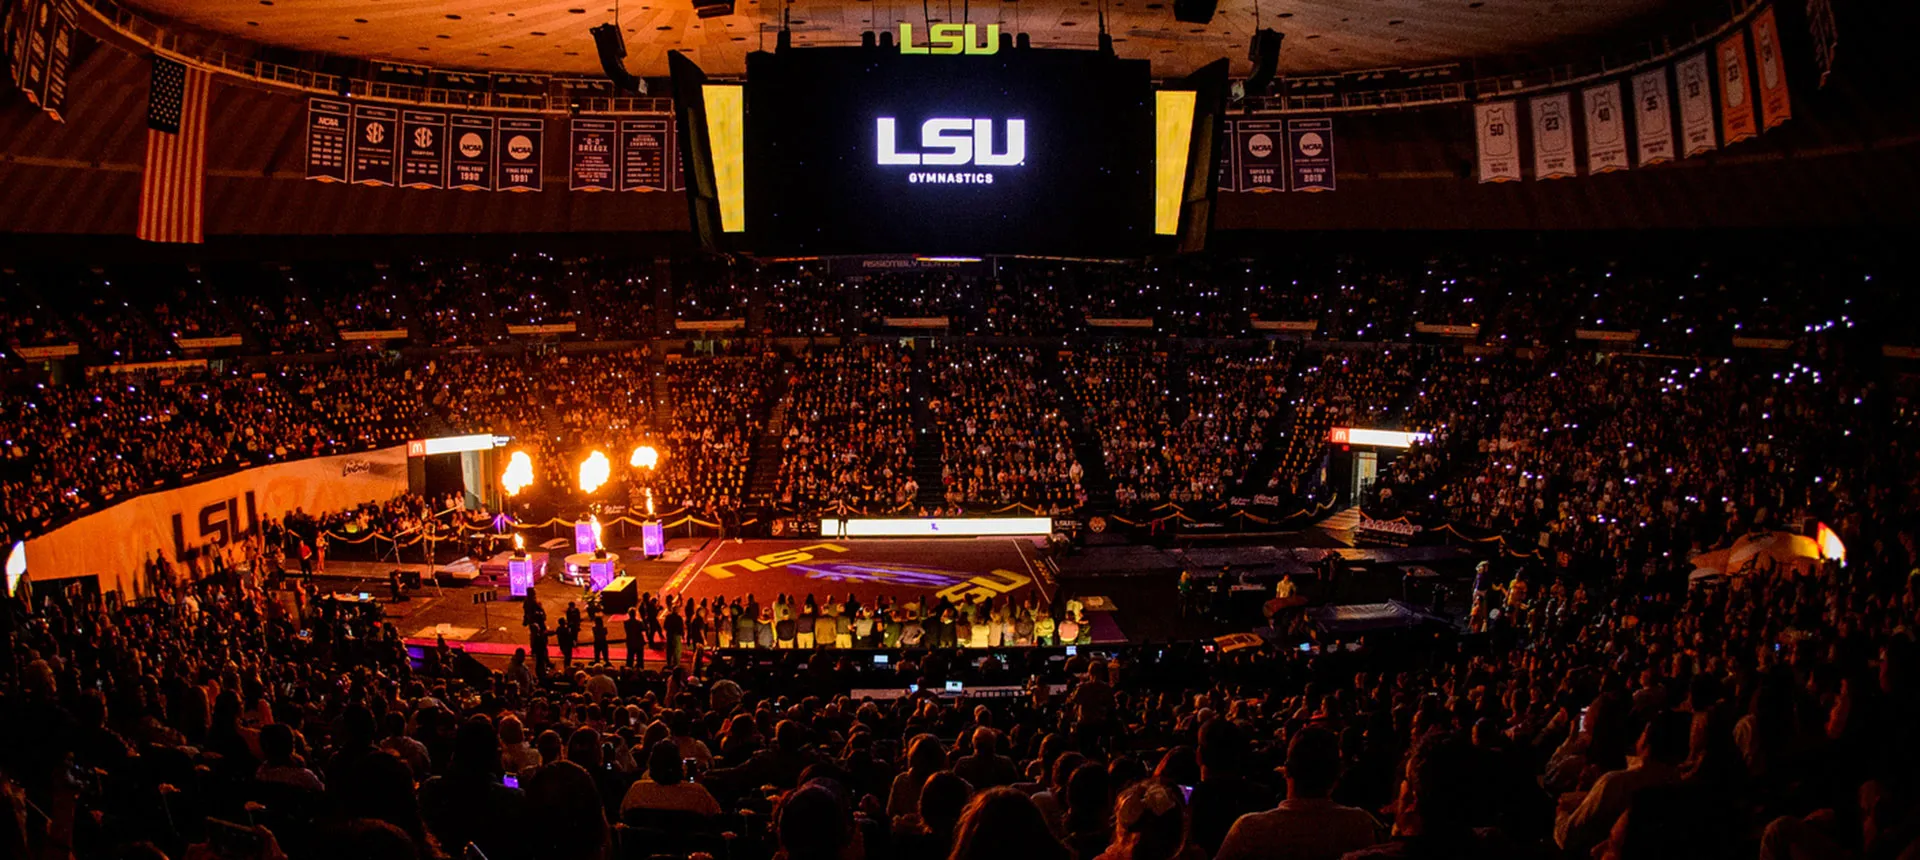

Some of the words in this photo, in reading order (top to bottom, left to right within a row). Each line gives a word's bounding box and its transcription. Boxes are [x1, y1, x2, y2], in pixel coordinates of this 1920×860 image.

[900, 23, 999, 54] LSU
[366, 122, 385, 144] SEC
[1490, 123, 1504, 136] 50
[1545, 117, 1559, 131] 23
[414, 127, 433, 148] SEC
[877, 117, 1025, 166] LSU
[908, 173, 993, 184] GYMNASTICS
[172, 490, 258, 562] LSU
[702, 543, 850, 579] LSU
[934, 568, 1032, 605] SU
